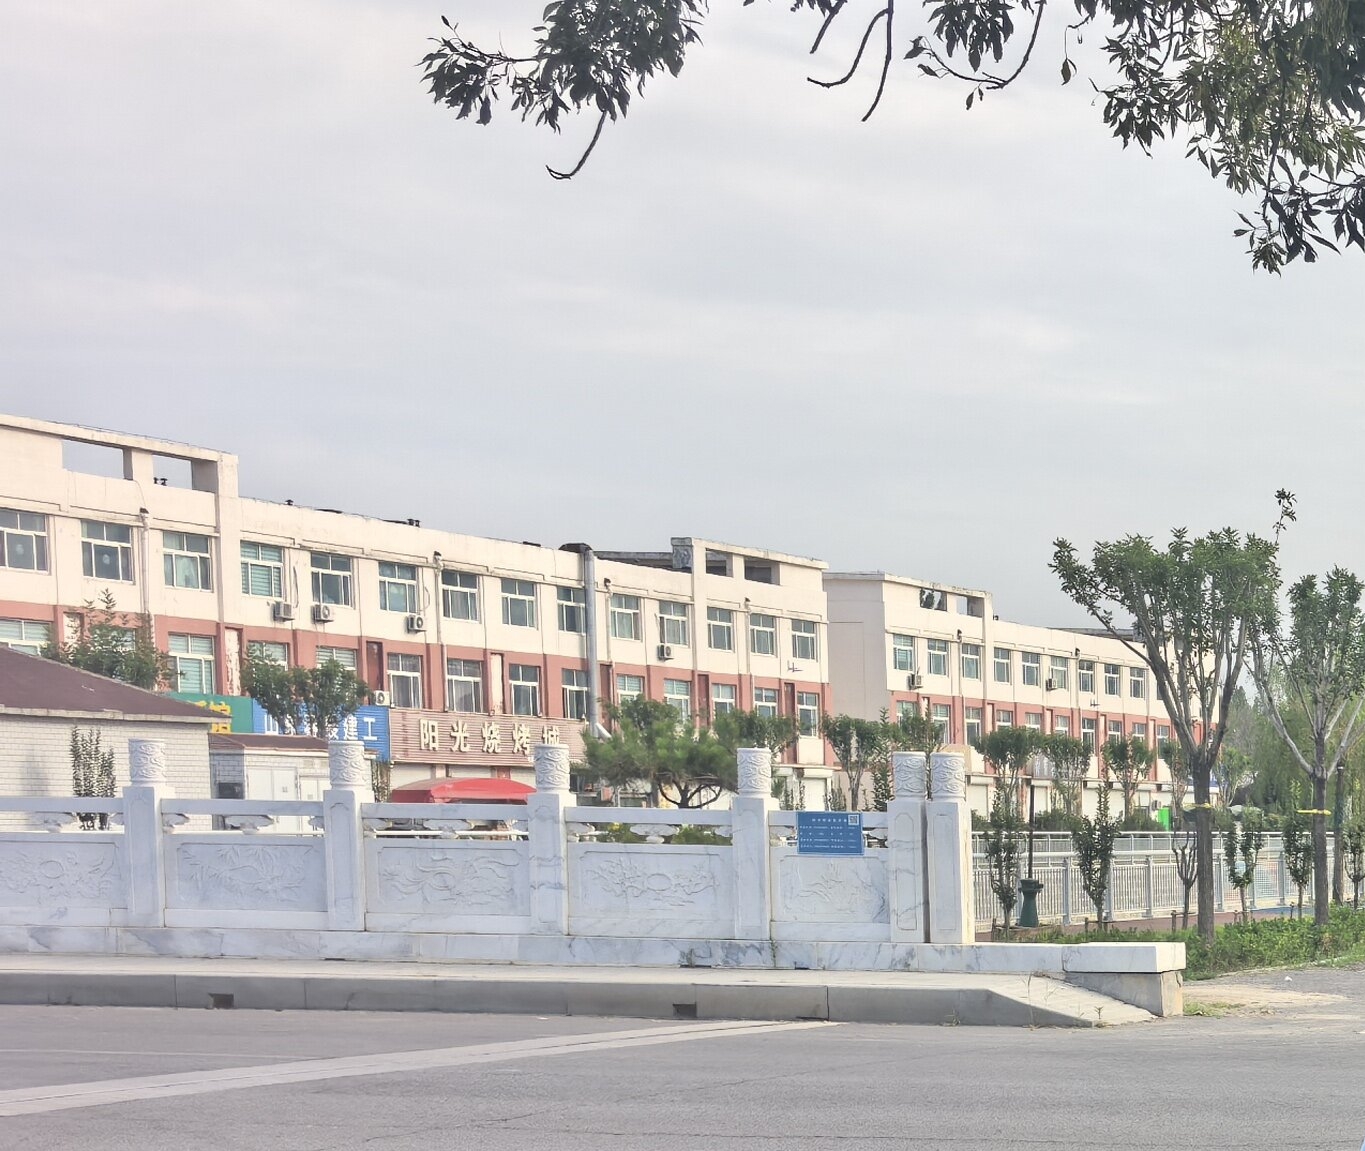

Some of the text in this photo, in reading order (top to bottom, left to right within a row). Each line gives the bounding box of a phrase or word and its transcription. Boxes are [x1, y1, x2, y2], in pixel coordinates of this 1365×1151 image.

[419, 718, 560, 754] 阳光烧烤城
